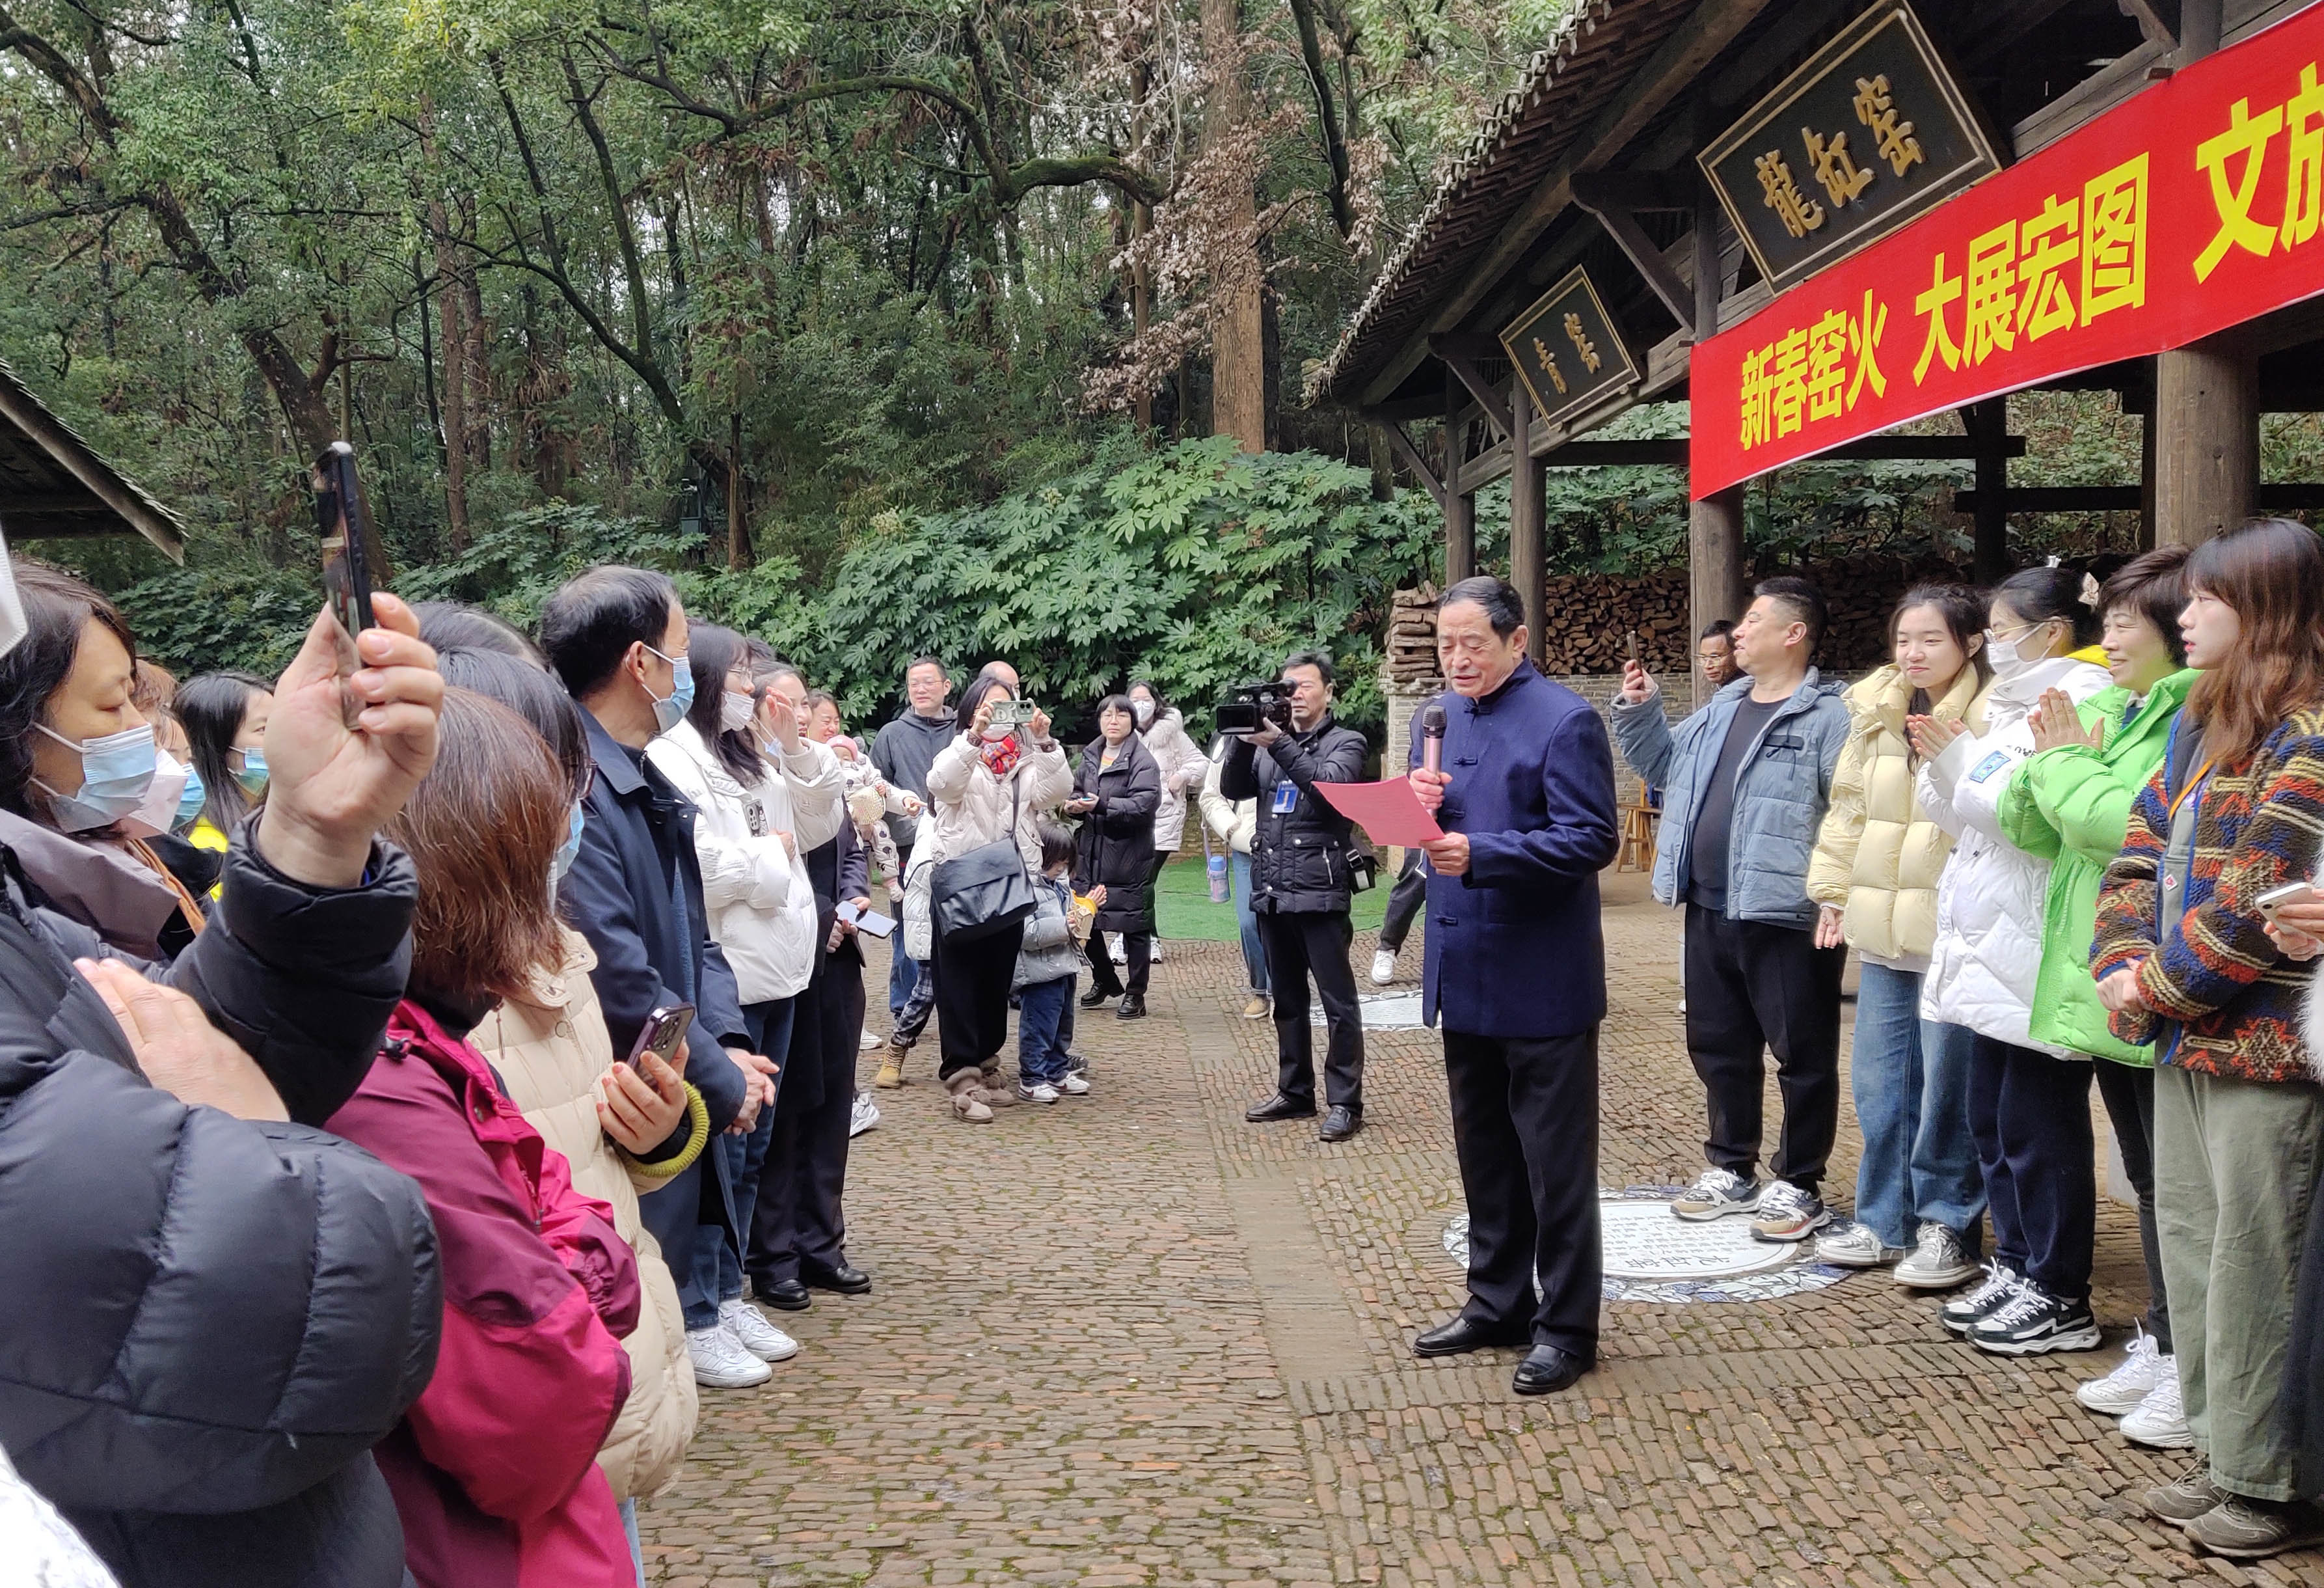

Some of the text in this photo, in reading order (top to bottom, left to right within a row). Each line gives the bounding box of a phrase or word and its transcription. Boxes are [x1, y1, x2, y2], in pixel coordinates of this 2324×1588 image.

[1754, 74, 1925, 238] 龍缸窑
[1740, 288, 1888, 451] 新春窑火
[1913, 151, 2149, 387] 大展宏图
